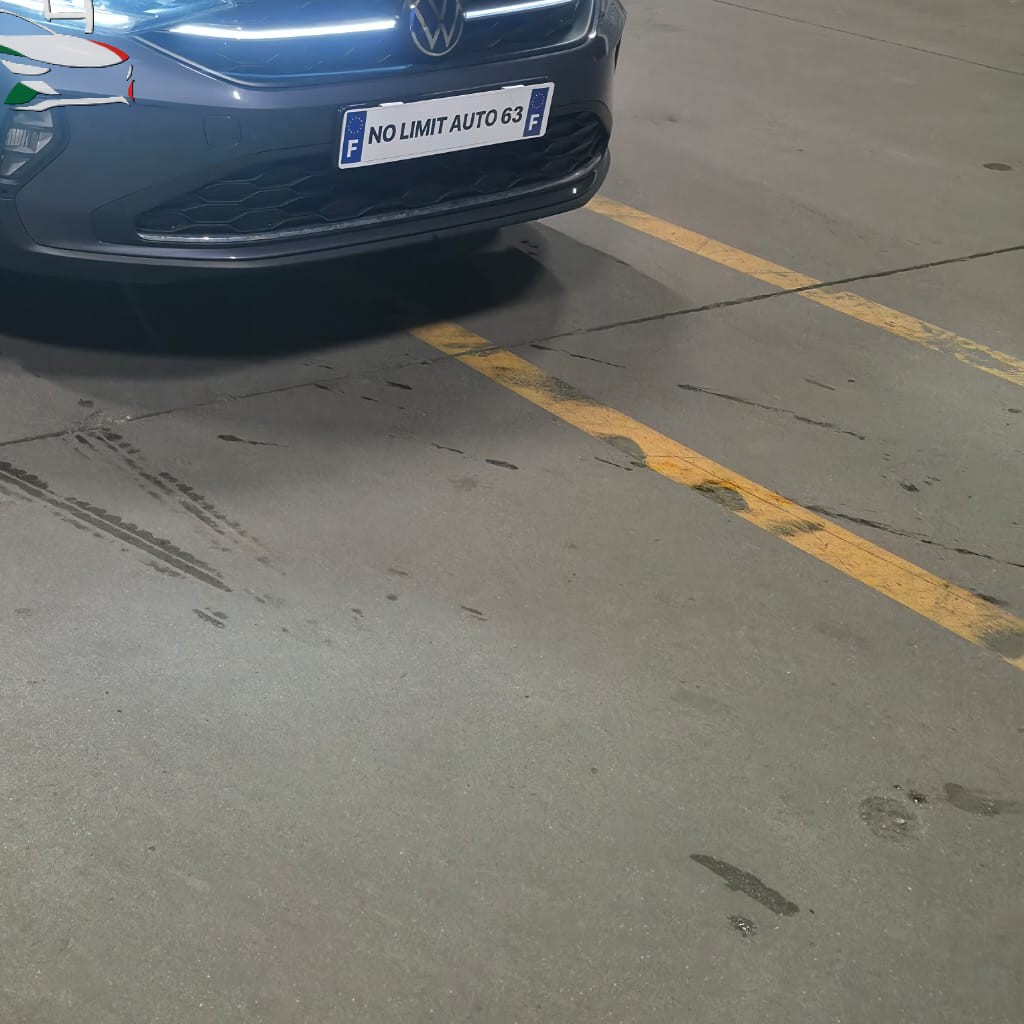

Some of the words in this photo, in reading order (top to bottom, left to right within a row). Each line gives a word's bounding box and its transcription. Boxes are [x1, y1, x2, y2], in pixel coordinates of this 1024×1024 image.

[367, 124, 396, 145] NO
[399, 116, 448, 140] LIMIT
[449, 108, 498, 133] AUTO
[500, 105, 524, 125] 63
[528, 113, 539, 131] F
[346, 139, 359, 158] F
